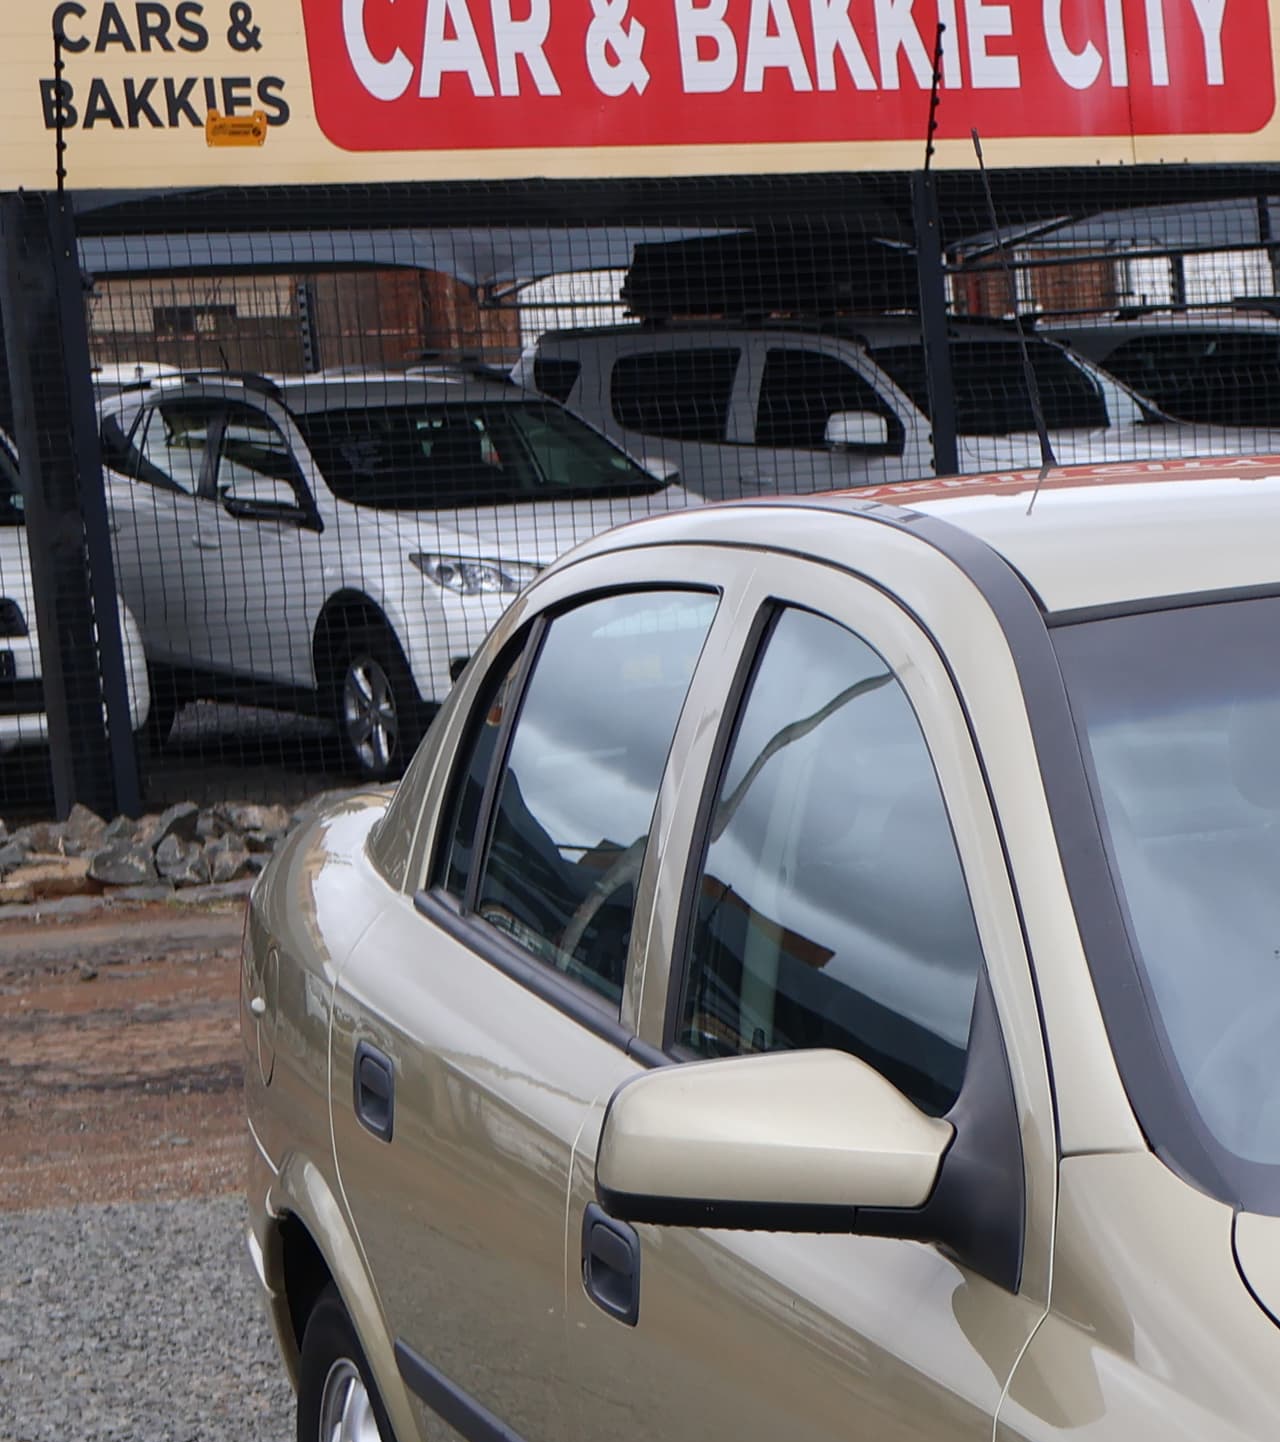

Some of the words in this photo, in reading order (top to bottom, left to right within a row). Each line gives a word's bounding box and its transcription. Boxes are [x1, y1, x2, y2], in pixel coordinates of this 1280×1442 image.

[52, 1, 209, 53] CARS
[226, 1, 262, 52] &
[341, 0, 562, 101] CAR
[585, 0, 651, 97] &
[674, 0, 1020, 94] BAKKIE
[1042, 0, 1226, 90] CITY
[38, 76, 290, 130] BAKKIES
